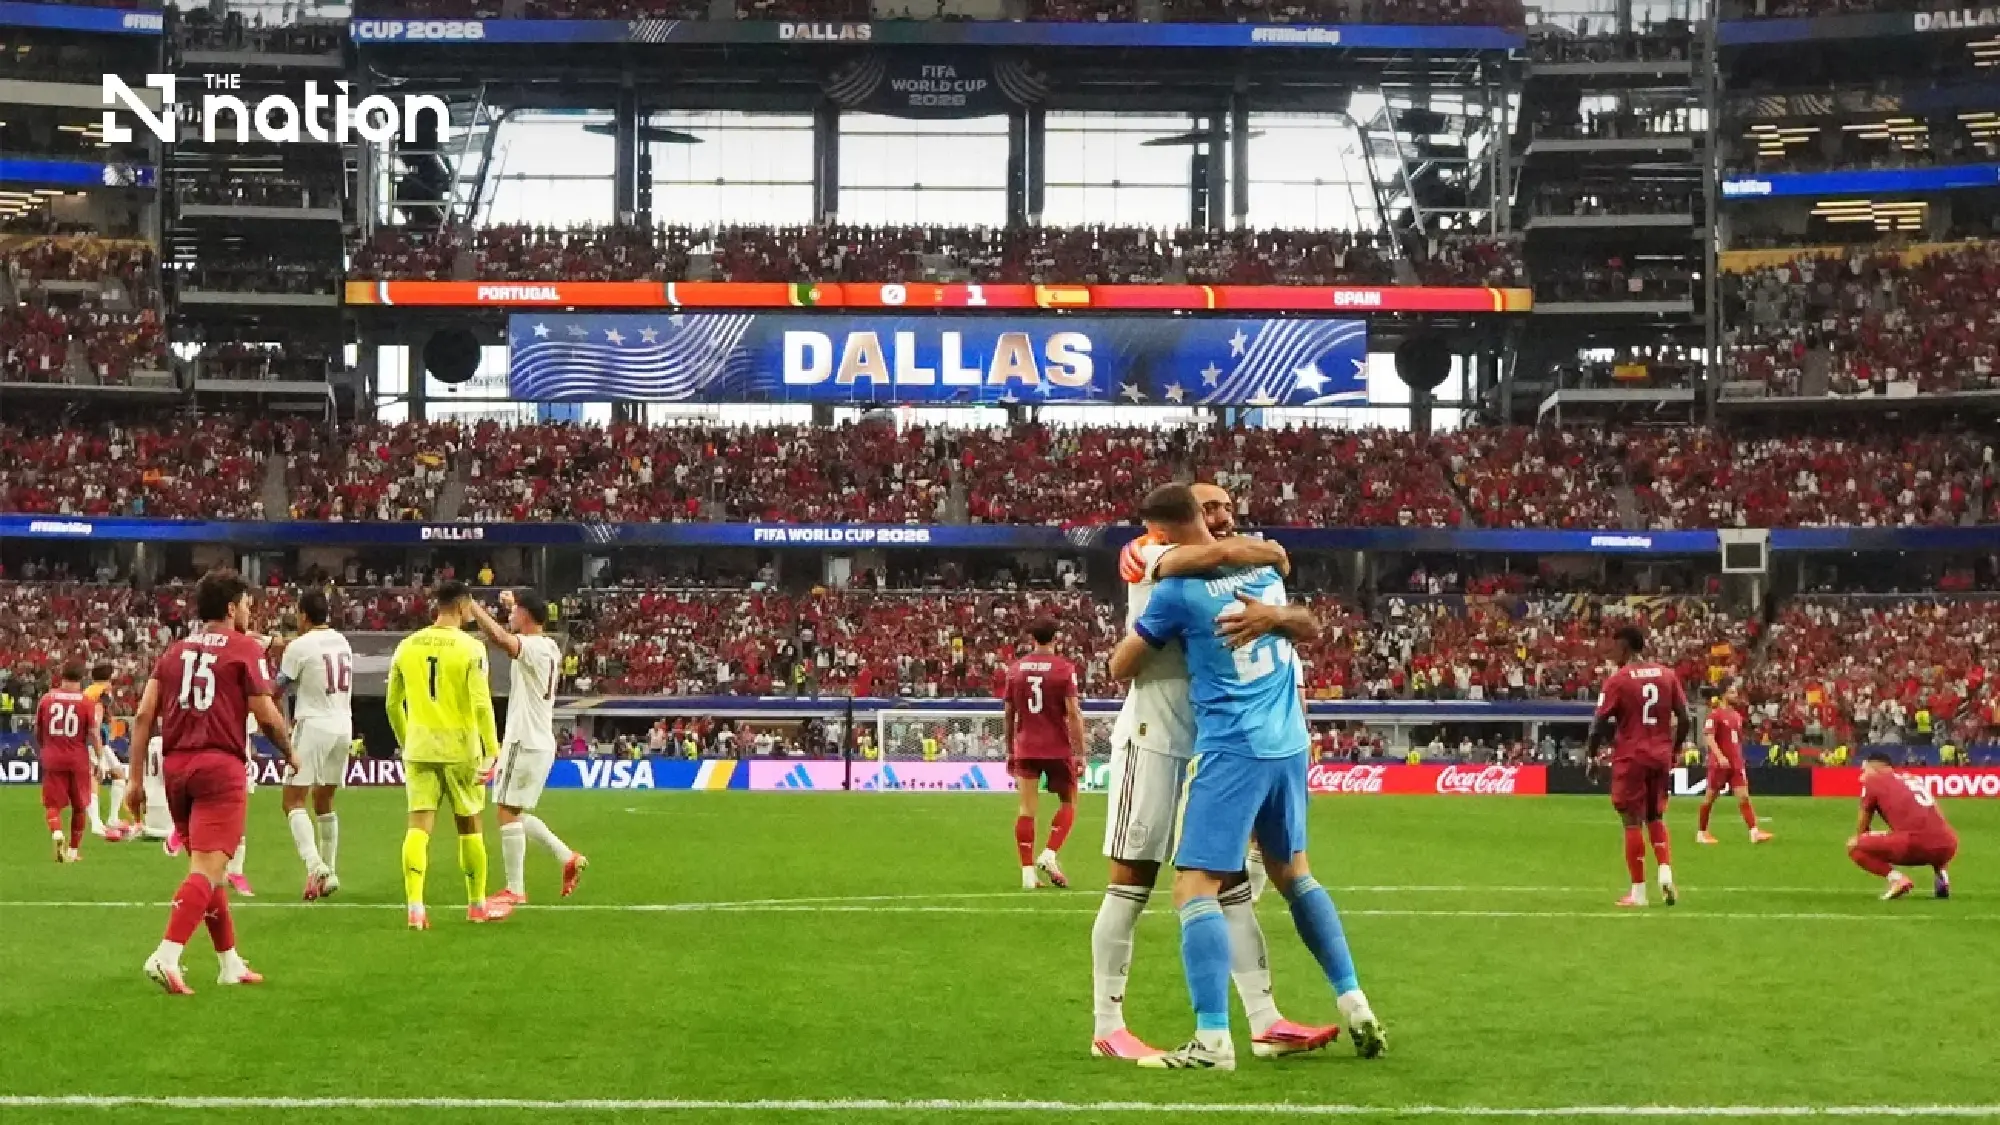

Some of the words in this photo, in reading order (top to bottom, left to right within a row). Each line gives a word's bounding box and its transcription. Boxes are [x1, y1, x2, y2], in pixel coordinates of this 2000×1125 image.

[359, 22, 404, 38] CUP
[405, 22, 485, 39] 2026
[780, 23, 871, 40] DALLAS
[922, 65, 957, 78] FIFA
[891, 80, 951, 92] WORLD
[954, 80, 988, 92] CUP
[908, 94, 967, 106] 2026
[477, 285, 560, 301] PORTUGAL
[967, 285, 987, 305] 1
[1334, 291, 1382, 306] SPAIN
[783, 331, 1093, 387] DALLAS
[421, 526, 484, 540] DALLAS
[754, 528, 786, 541] FIFA
[789, 528, 843, 541] WORLD
[845, 528, 875, 542] CUP
[876, 528, 930, 543] 2026
[178, 650, 218, 711] 15
[322, 652, 351, 694] 16
[426, 656, 438, 702] 1
[1027, 676, 1043, 713] 3
[1642, 683, 1658, 725] 2
[49, 702, 79, 737] 26
[571, 760, 655, 788] VISA
